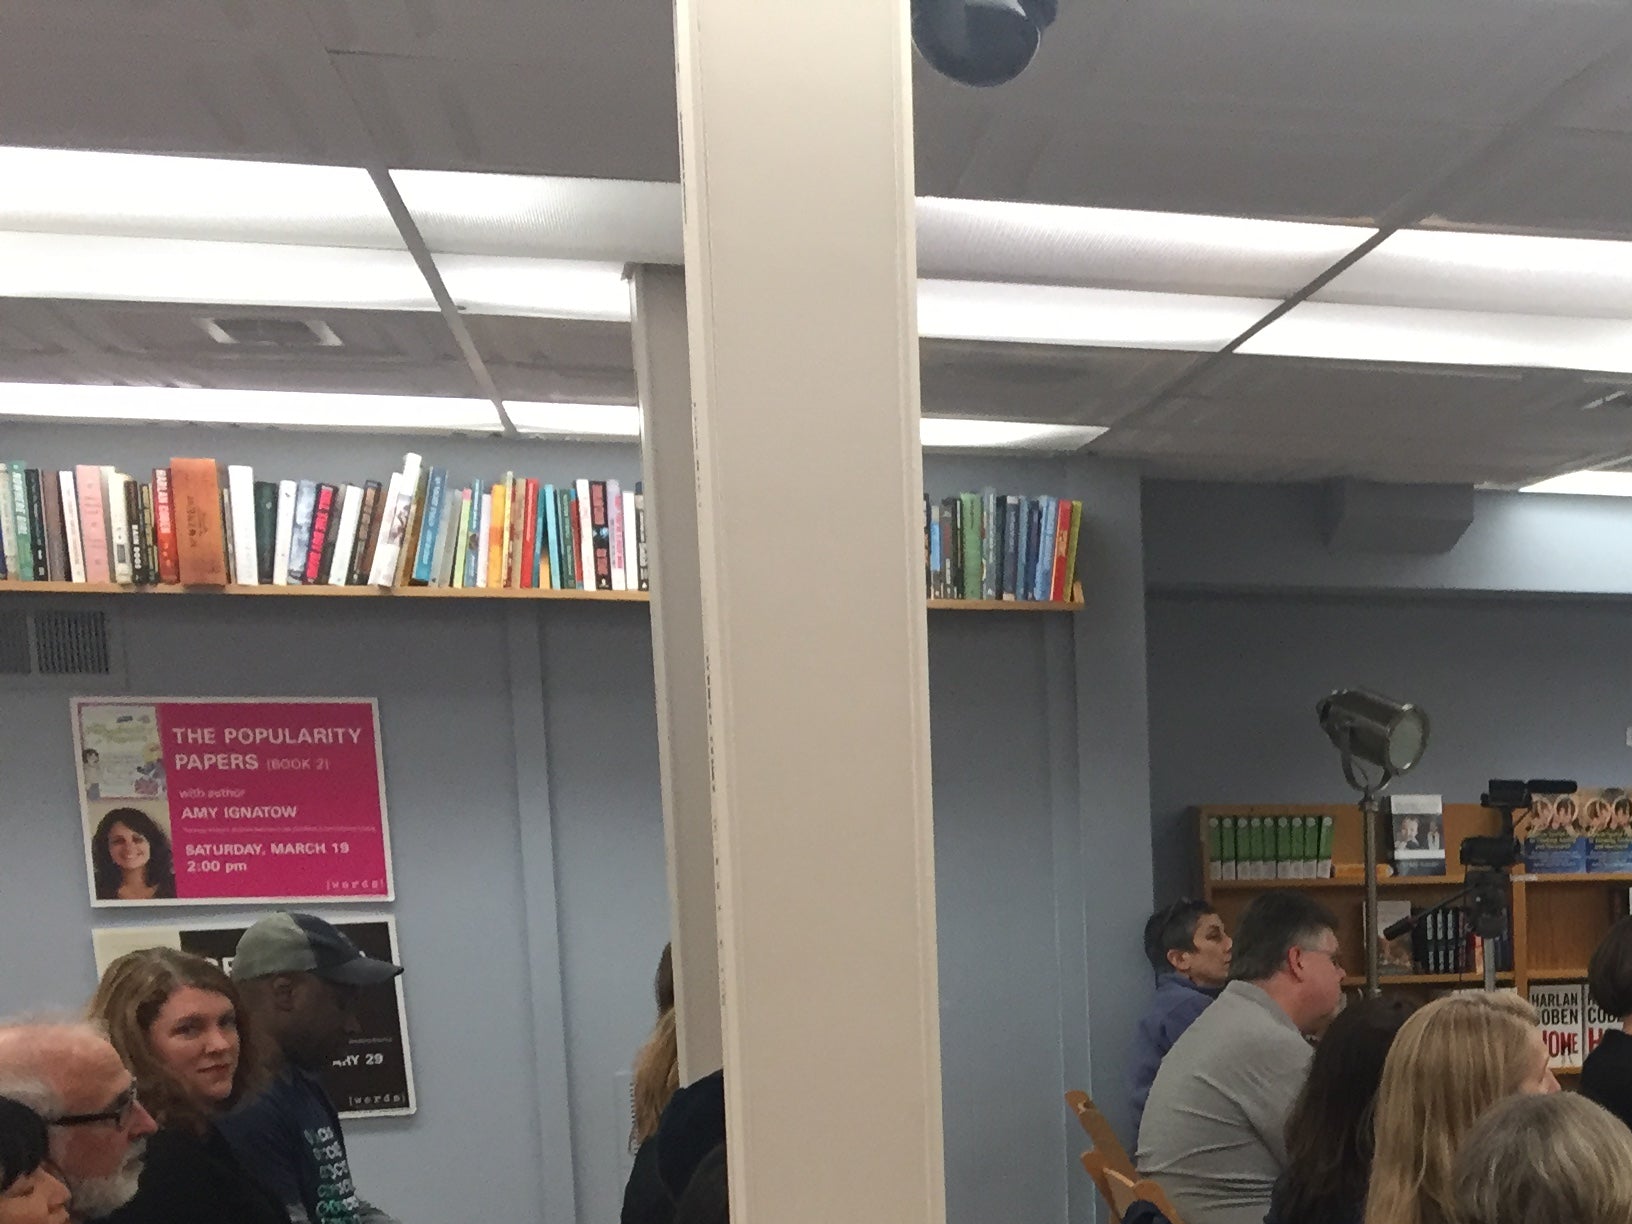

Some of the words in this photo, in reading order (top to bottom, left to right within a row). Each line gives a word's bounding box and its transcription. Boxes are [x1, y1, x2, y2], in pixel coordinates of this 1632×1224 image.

[172, 727, 217, 745] THE
[223, 727, 362, 745] POPULARITY
[174, 753, 259, 770] PAPERS
[179, 787, 205, 799] with
[207, 787, 246, 799] author
[181, 806, 218, 820] AMY
[223, 805, 297, 819] IGNATOW
[270, 842, 327, 855] MARCH
[332, 841, 350, 854] 19
[187, 860, 221, 873] 2:00
[225, 861, 247, 873] pm
[1531, 992, 1578, 1008] HARLAN
[1541, 1008, 1578, 1025] OBEN
[365, 1053, 384, 1065] 29
